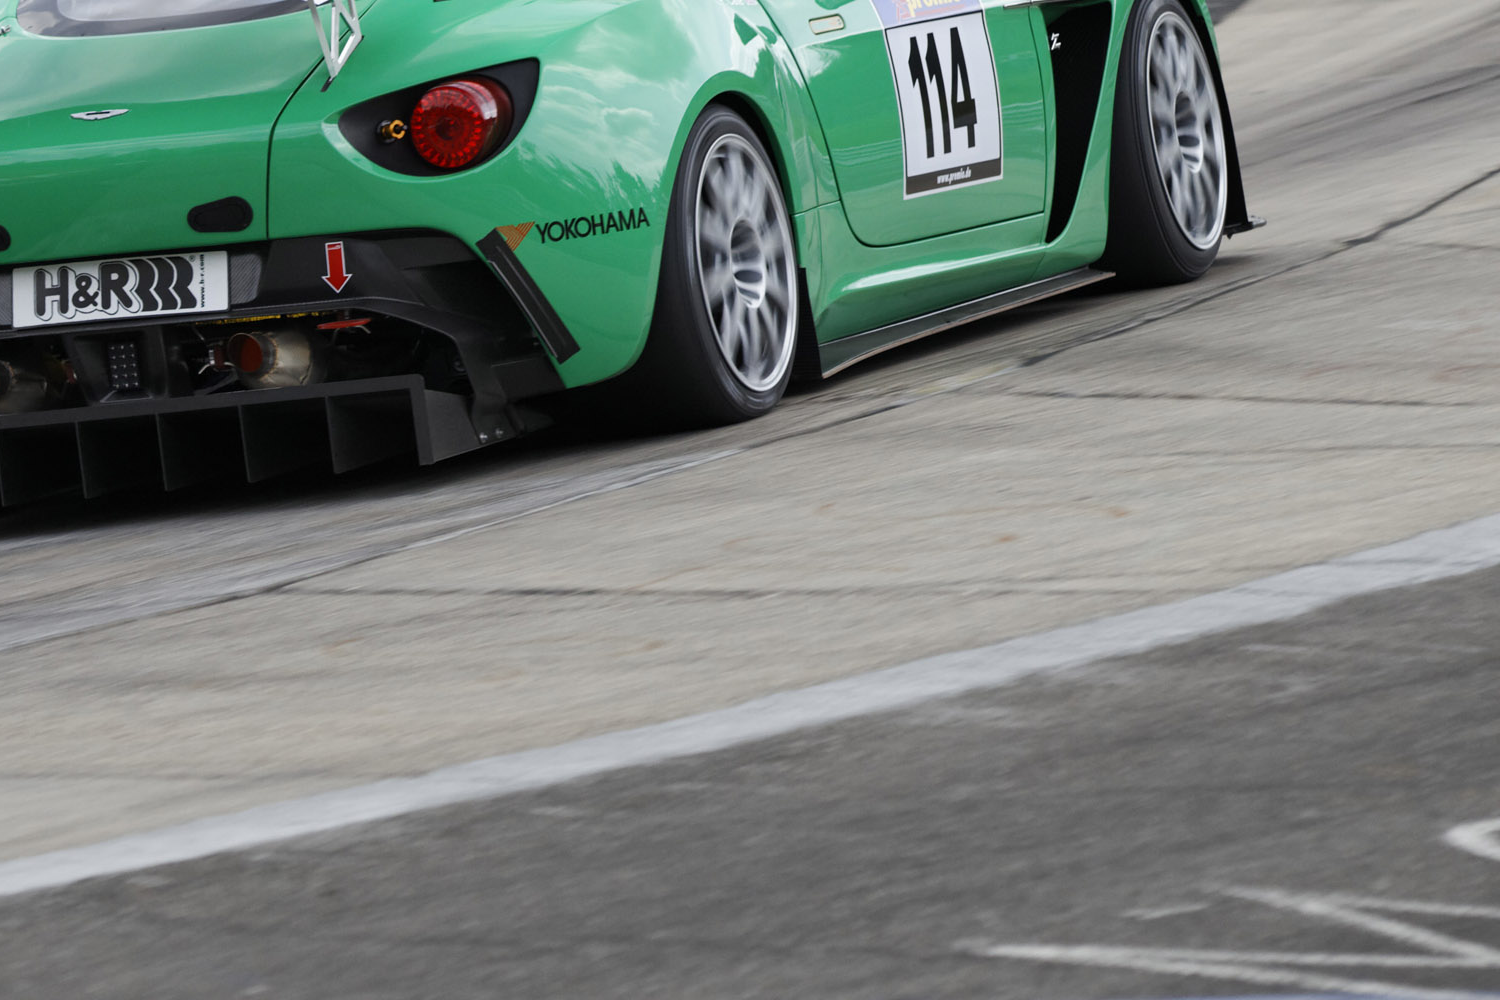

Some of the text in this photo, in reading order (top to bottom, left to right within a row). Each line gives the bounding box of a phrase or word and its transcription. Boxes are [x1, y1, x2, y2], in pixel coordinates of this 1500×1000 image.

[908, 26, 978, 159] 114
[535, 207, 650, 244] YOKOHAMA
[33, 258, 145, 321] H&R
